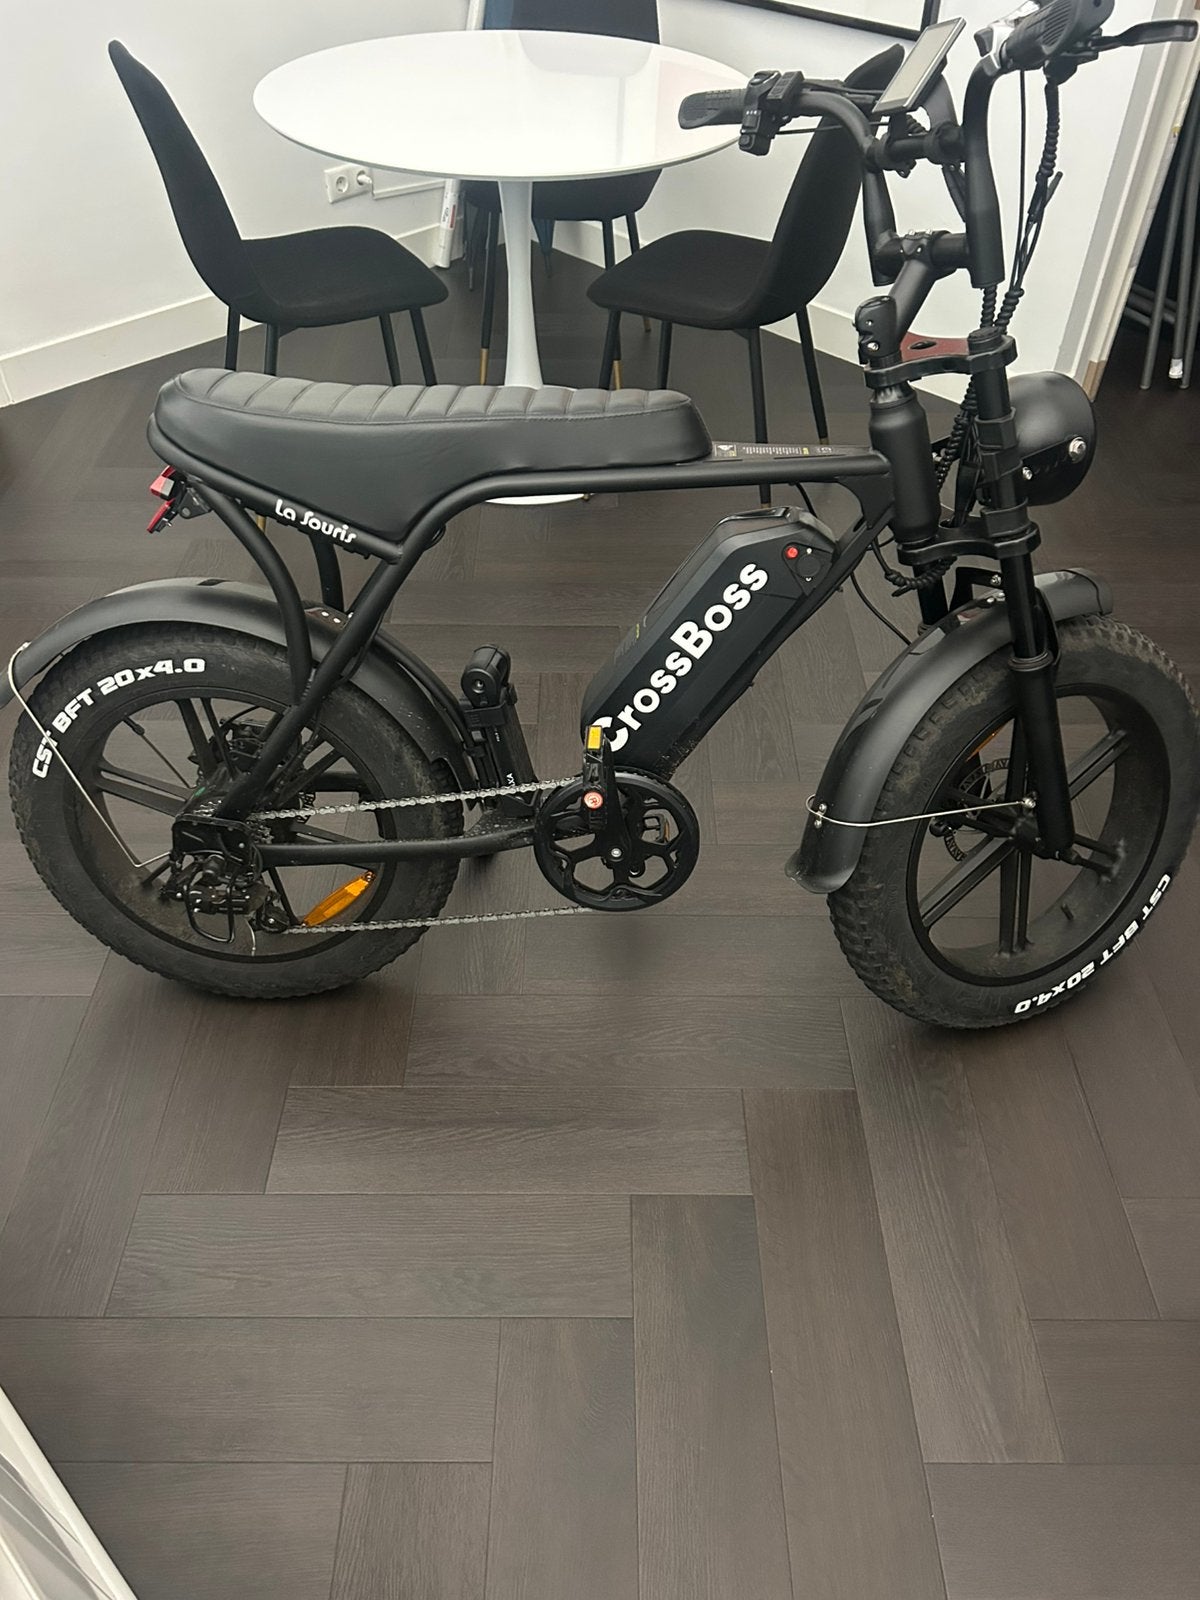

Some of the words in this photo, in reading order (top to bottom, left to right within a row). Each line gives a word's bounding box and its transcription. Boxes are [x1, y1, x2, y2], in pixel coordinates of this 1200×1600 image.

[275, 499, 297, 521] La
[300, 511, 357, 543] Souris
[592, 563, 769, 752] CrossBoss
[31, 730, 58, 779] CST
[51, 687, 95, 734] BFT
[96, 658, 206, 696] 20x4.0
[1142, 873, 1171, 921] CST
[1100, 920, 1139, 966] BFT
[1014, 961, 1095, 1014] 20x4.0
